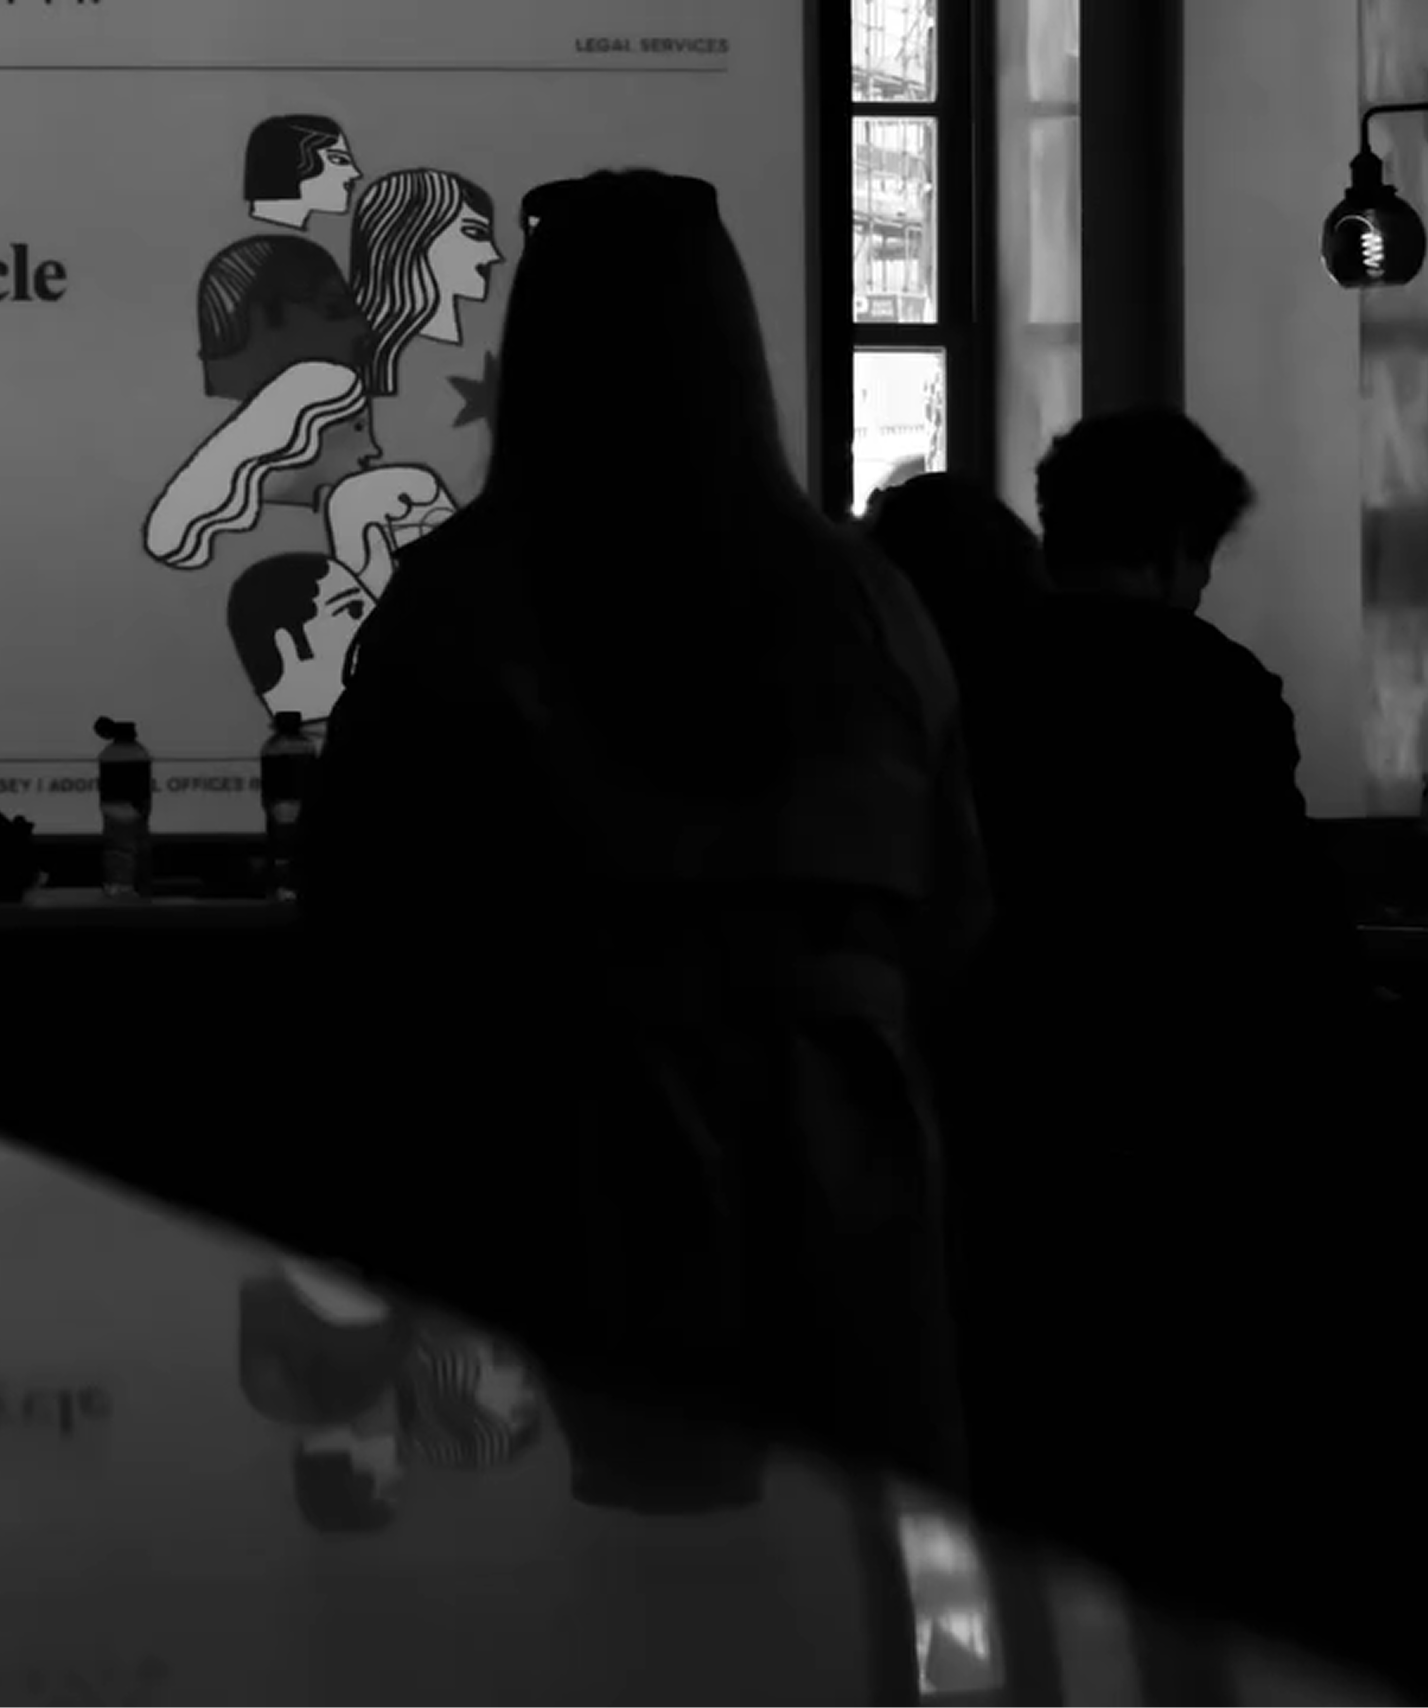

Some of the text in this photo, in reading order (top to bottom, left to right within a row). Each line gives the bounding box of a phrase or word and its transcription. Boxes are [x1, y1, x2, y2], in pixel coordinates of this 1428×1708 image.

[575, 37, 729, 53] LEGAL SERVICES
[166, 776, 244, 793] OFFICES
